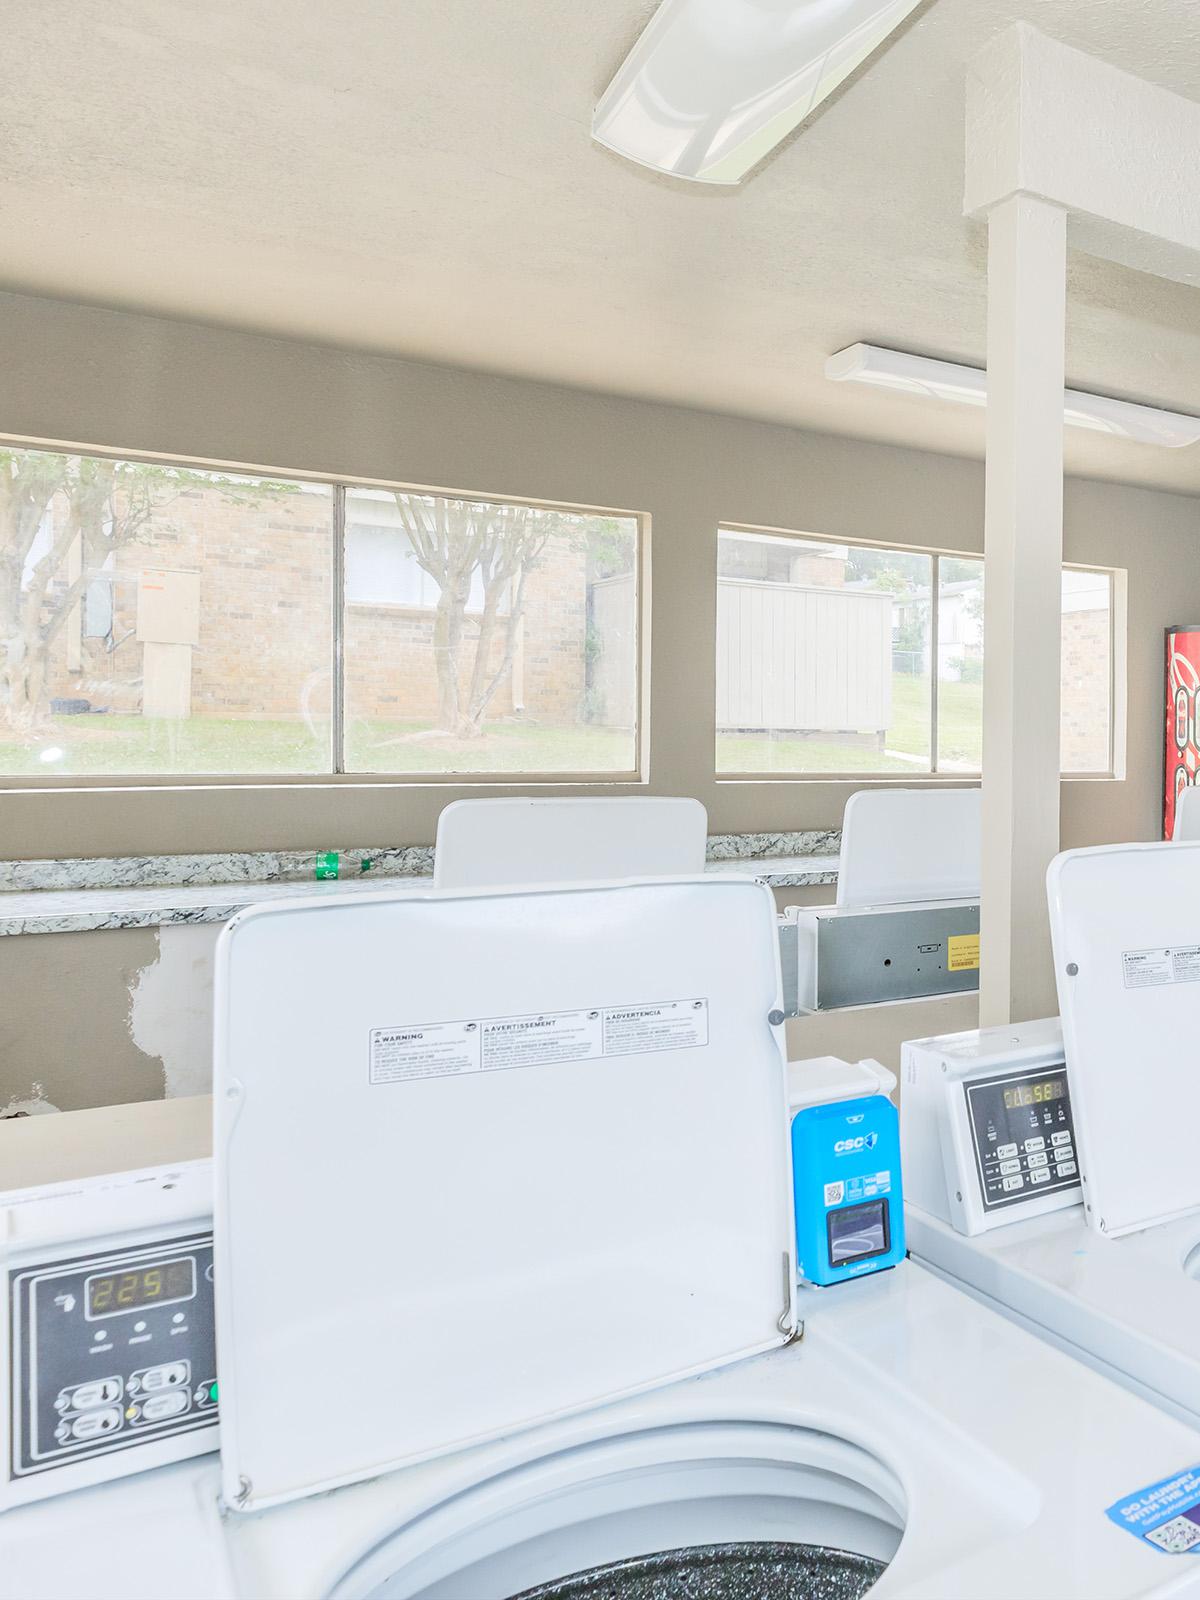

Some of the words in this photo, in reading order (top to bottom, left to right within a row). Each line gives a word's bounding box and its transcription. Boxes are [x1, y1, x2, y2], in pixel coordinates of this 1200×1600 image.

[611, 1010, 661, 1020] ADVERTENCIA
[491, 1020, 557, 1032] AVERTISSEMENT
[382, 1032, 424, 1043] WARNING
[833, 1136, 865, 1153] CSC
[1120, 1502, 1141, 1516] DO
[1140, 1472, 1194, 1506] LAUNDRY
[1125, 1503, 1160, 1523] WITH
[1158, 1489, 1185, 1505] THE
